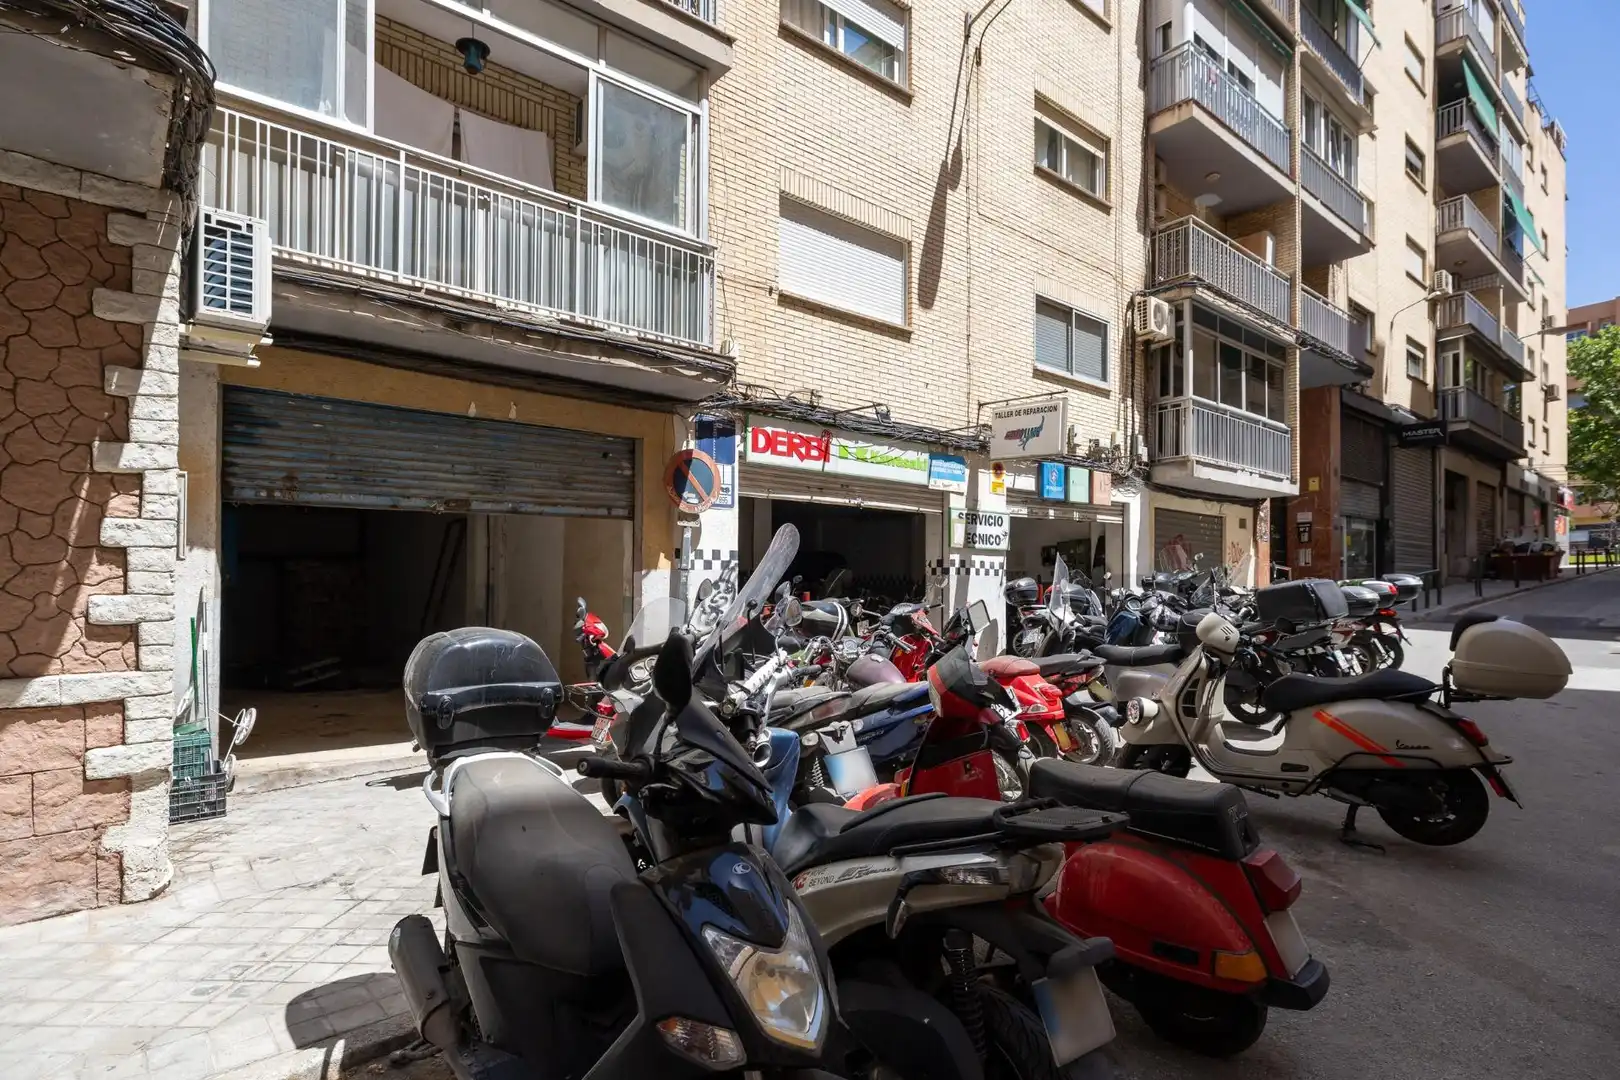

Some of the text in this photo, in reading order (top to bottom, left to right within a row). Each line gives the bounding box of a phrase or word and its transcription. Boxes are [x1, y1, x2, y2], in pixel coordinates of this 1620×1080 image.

[995, 405, 1058, 419] TALLER DE REPARACION
[1402, 428, 1444, 437] MASTER
[751, 427, 830, 462] DERBI
[958, 512, 1003, 527] SERVICIO
[966, 533, 1001, 546] ECNICO
[808, 876, 834, 887] BEYOND
